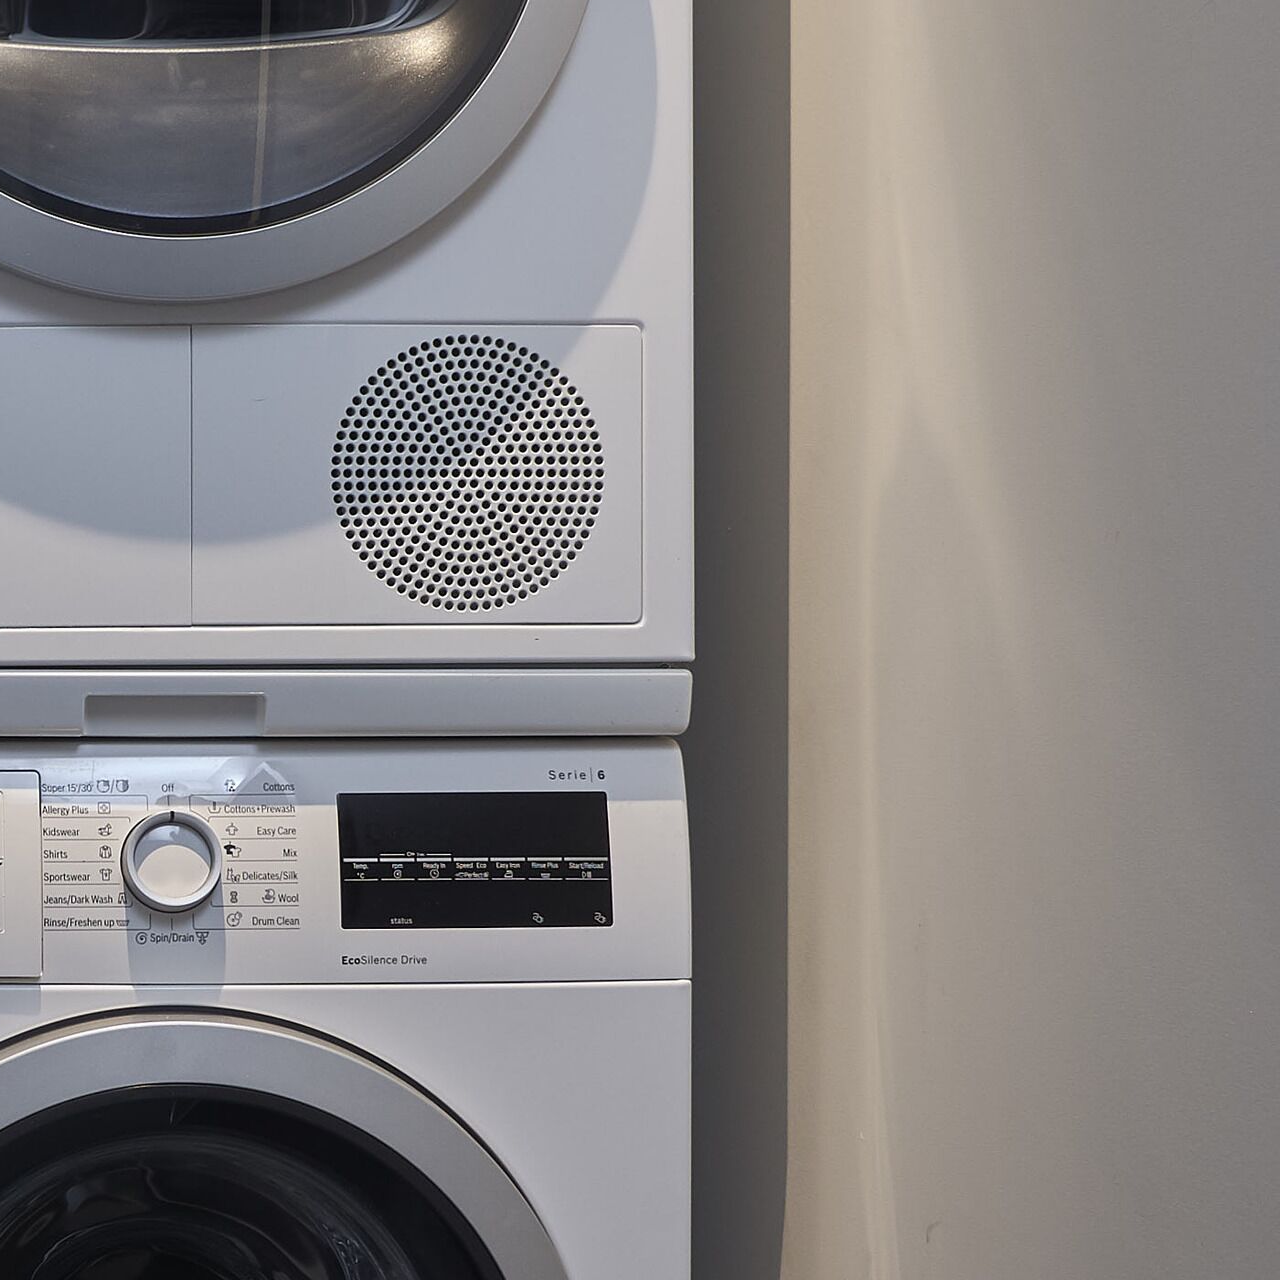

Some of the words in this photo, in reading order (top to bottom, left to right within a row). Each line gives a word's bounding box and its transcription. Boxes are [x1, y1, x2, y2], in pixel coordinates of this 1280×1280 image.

[548, 770, 587, 780] Serie
[597, 770, 605, 780] 6
[41, 783, 65, 793] Super
[161, 783, 174, 793] Off
[263, 782, 295, 792] Cottons
[43, 805, 70, 816] Allergy
[72, 805, 89, 814] Plus
[43, 827, 80, 837] Kidswear
[257, 826, 276, 837] Easy
[277, 826, 297, 836] Care
[44, 850, 68, 859] Shirts
[283, 848, 298, 857] Mix
[44, 872, 90, 883] Sportswear
[242, 871, 298, 881] Delicates/Silk
[44, 894, 90, 905] Jeans/Dark
[91, 894, 113, 904] Wash
[278, 894, 299, 903] Wool
[44, 917, 103, 928] Rinse/Freshen
[104, 919, 115, 928] up
[252, 917, 275, 926] Drum
[276, 916, 300, 926] Clean
[150, 933, 195, 944] Spin/Drain
[342, 955, 398, 965] EcoSilence
[401, 955, 427, 965] Drive
